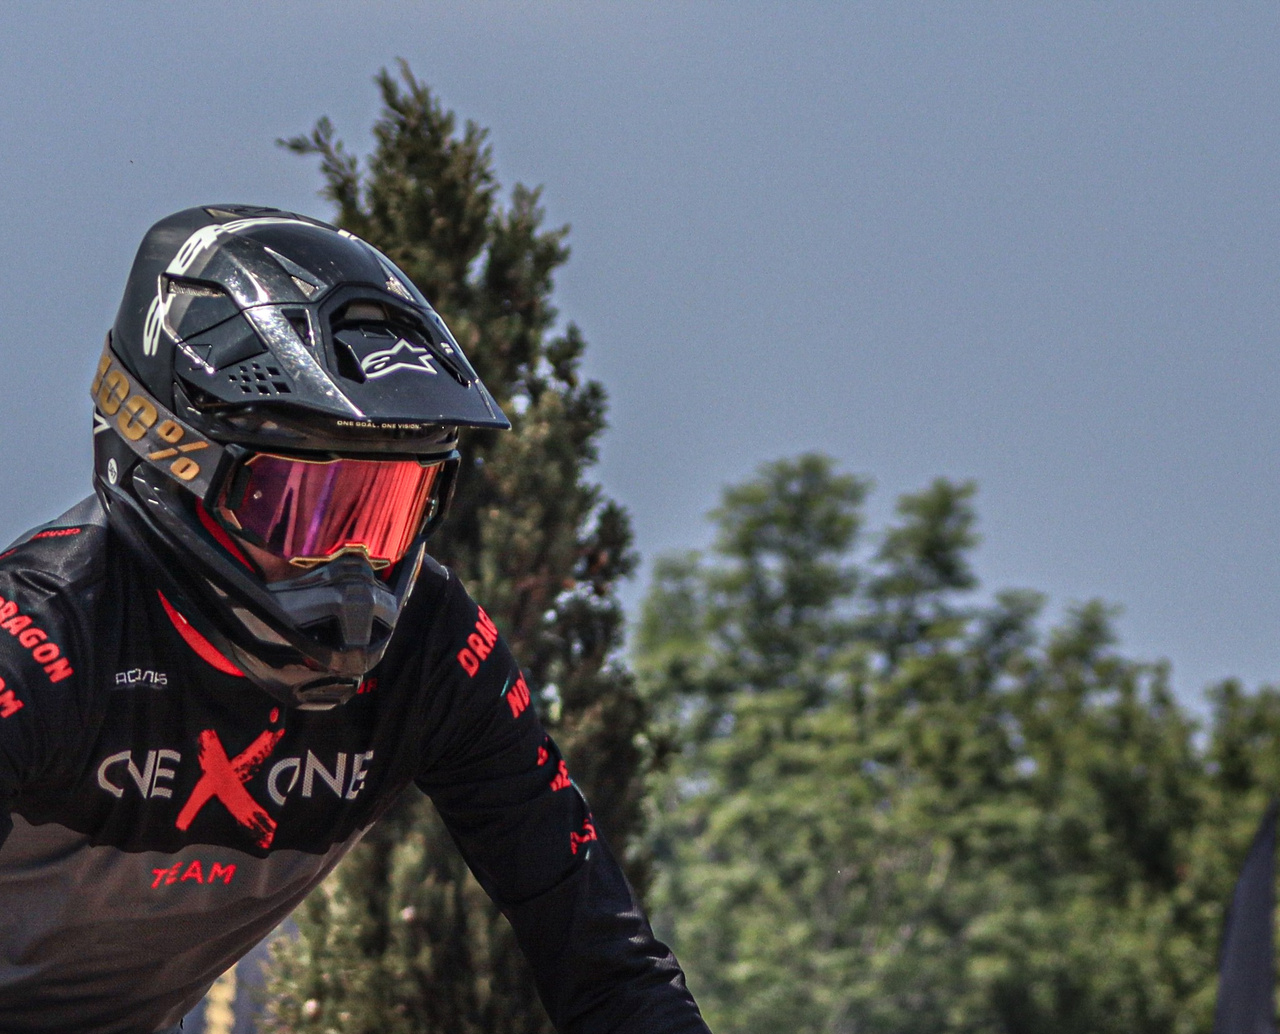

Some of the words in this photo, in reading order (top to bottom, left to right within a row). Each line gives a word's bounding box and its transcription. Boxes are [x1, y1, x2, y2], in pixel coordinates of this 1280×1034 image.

[90, 354, 201, 481] 100%
[267, 749, 374, 806] ONE
[151, 859, 237, 890] TEAM
